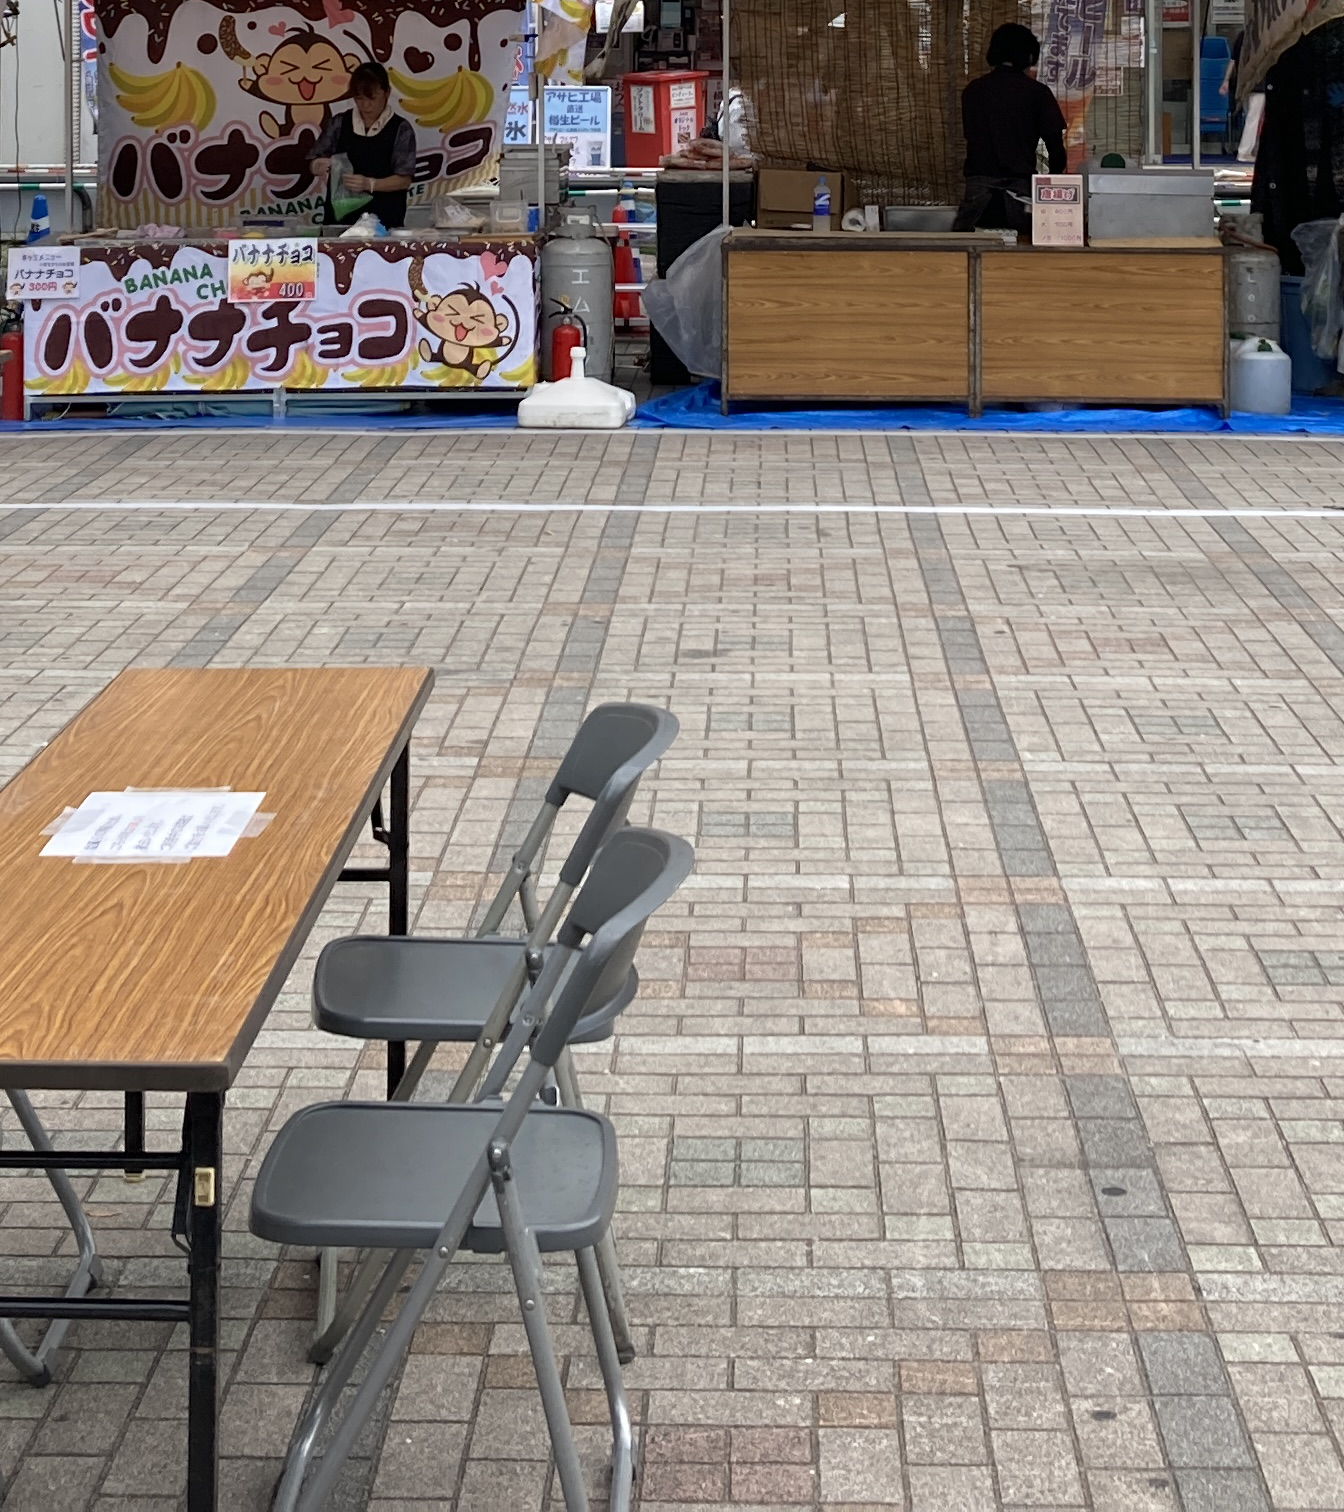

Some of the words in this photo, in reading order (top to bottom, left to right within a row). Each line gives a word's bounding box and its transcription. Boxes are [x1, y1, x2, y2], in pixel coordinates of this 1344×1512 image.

[545, 91, 603, 104] アサヒ工場
[1039, 187, 1077, 201] 唐揚げ
[231, 243, 315, 266] バナナチョコ
[14, 268, 74, 280] バナナチョコ
[123, 264, 214, 294] BANANA
[28, 281, 58, 292] 300円
[42, 292, 413, 373] バナナチョコ
